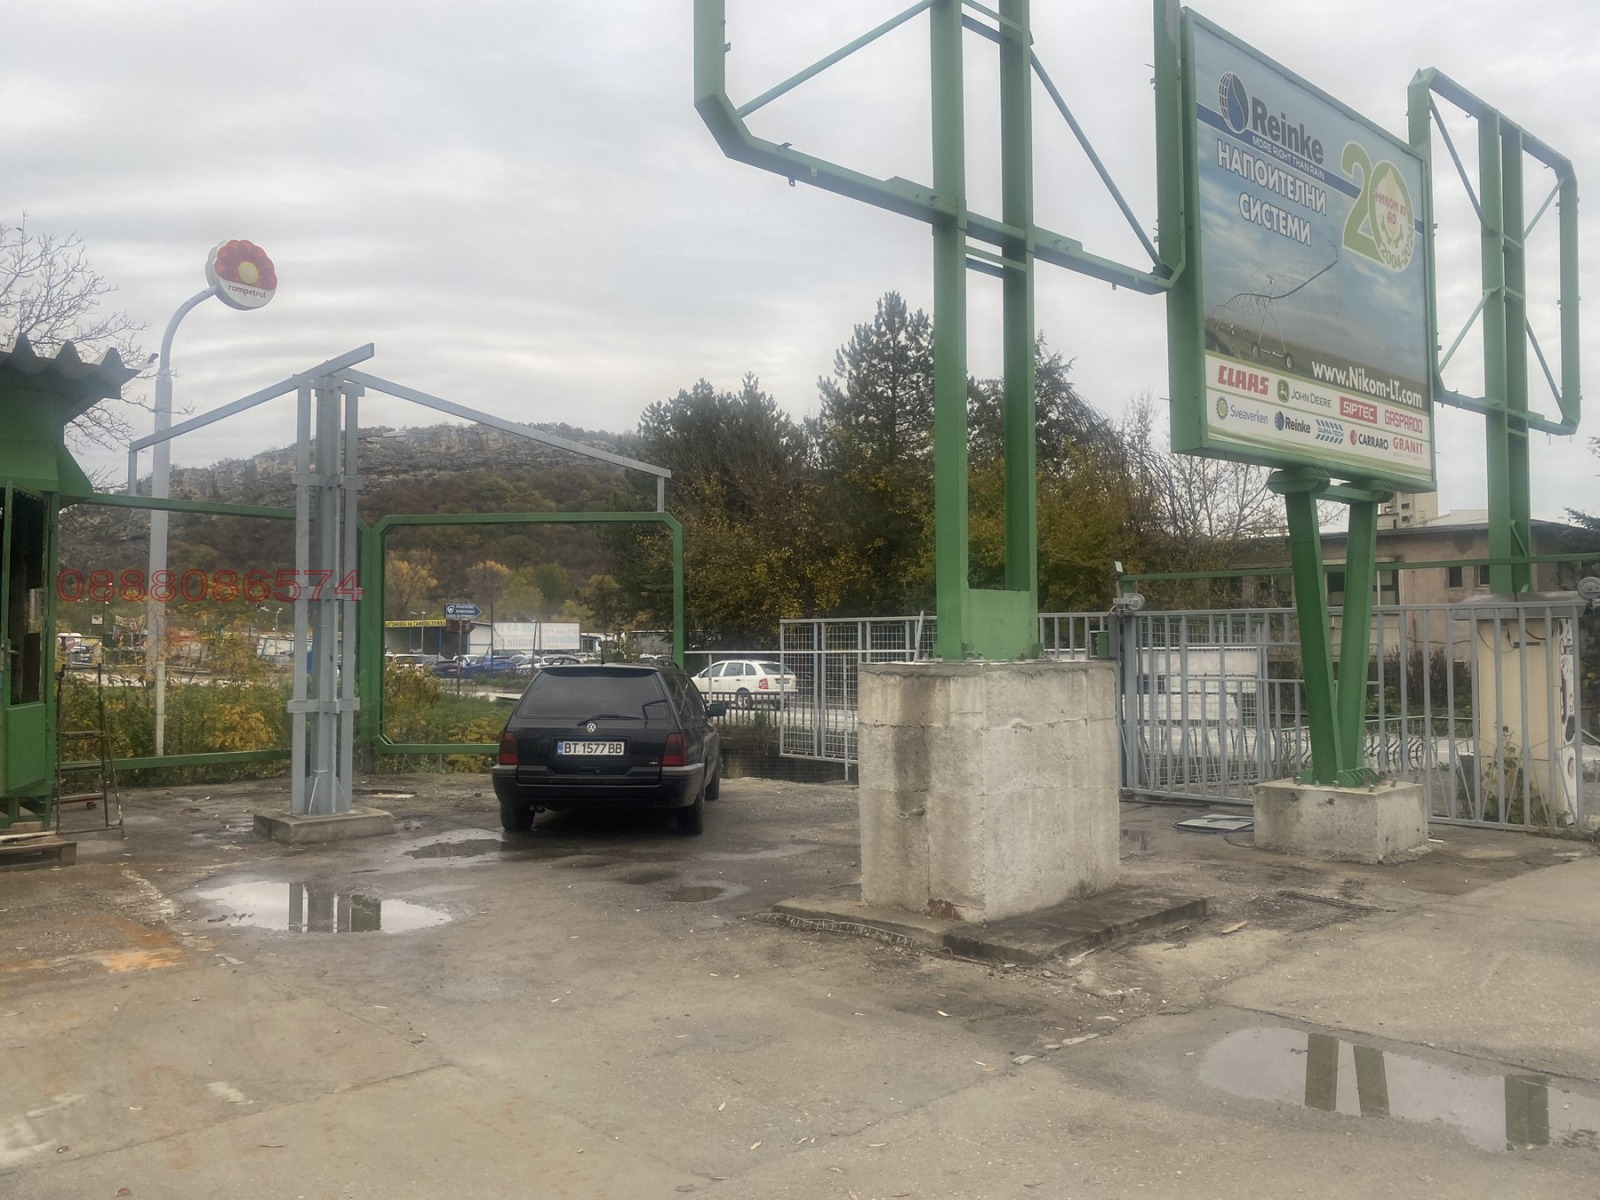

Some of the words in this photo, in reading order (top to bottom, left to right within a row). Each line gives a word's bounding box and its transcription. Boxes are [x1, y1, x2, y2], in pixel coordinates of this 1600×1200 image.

[1252, 97, 1324, 164] Reinke
[1252, 135, 1272, 154] MORE
[1272, 147, 1291, 163] RIGHT
[1292, 156, 1310, 173] THAN
[1309, 165, 1325, 181] RAIN
[1217, 139, 1327, 216] НАПОИТЕЛНИ
[1238, 192, 1312, 247] СИСТЕМИ
[228, 284, 266, 299] rompetrol
[1218, 365, 1269, 395] CLAAS
[1311, 361, 1423, 408] www.Nikom-LT.com
[1291, 388, 1310, 403] JOHN
[1310, 392, 1332, 409] DEERE
[1230, 404, 1269, 425] Sveaverken
[1342, 401, 1376, 421] SIPTEC
[1384, 409, 1424, 434] GASPARDO
[1285, 416, 1311, 434] Reinke
[1358, 432, 1389, 451] CARRARO
[1392, 436, 1424, 456] GRANIT
